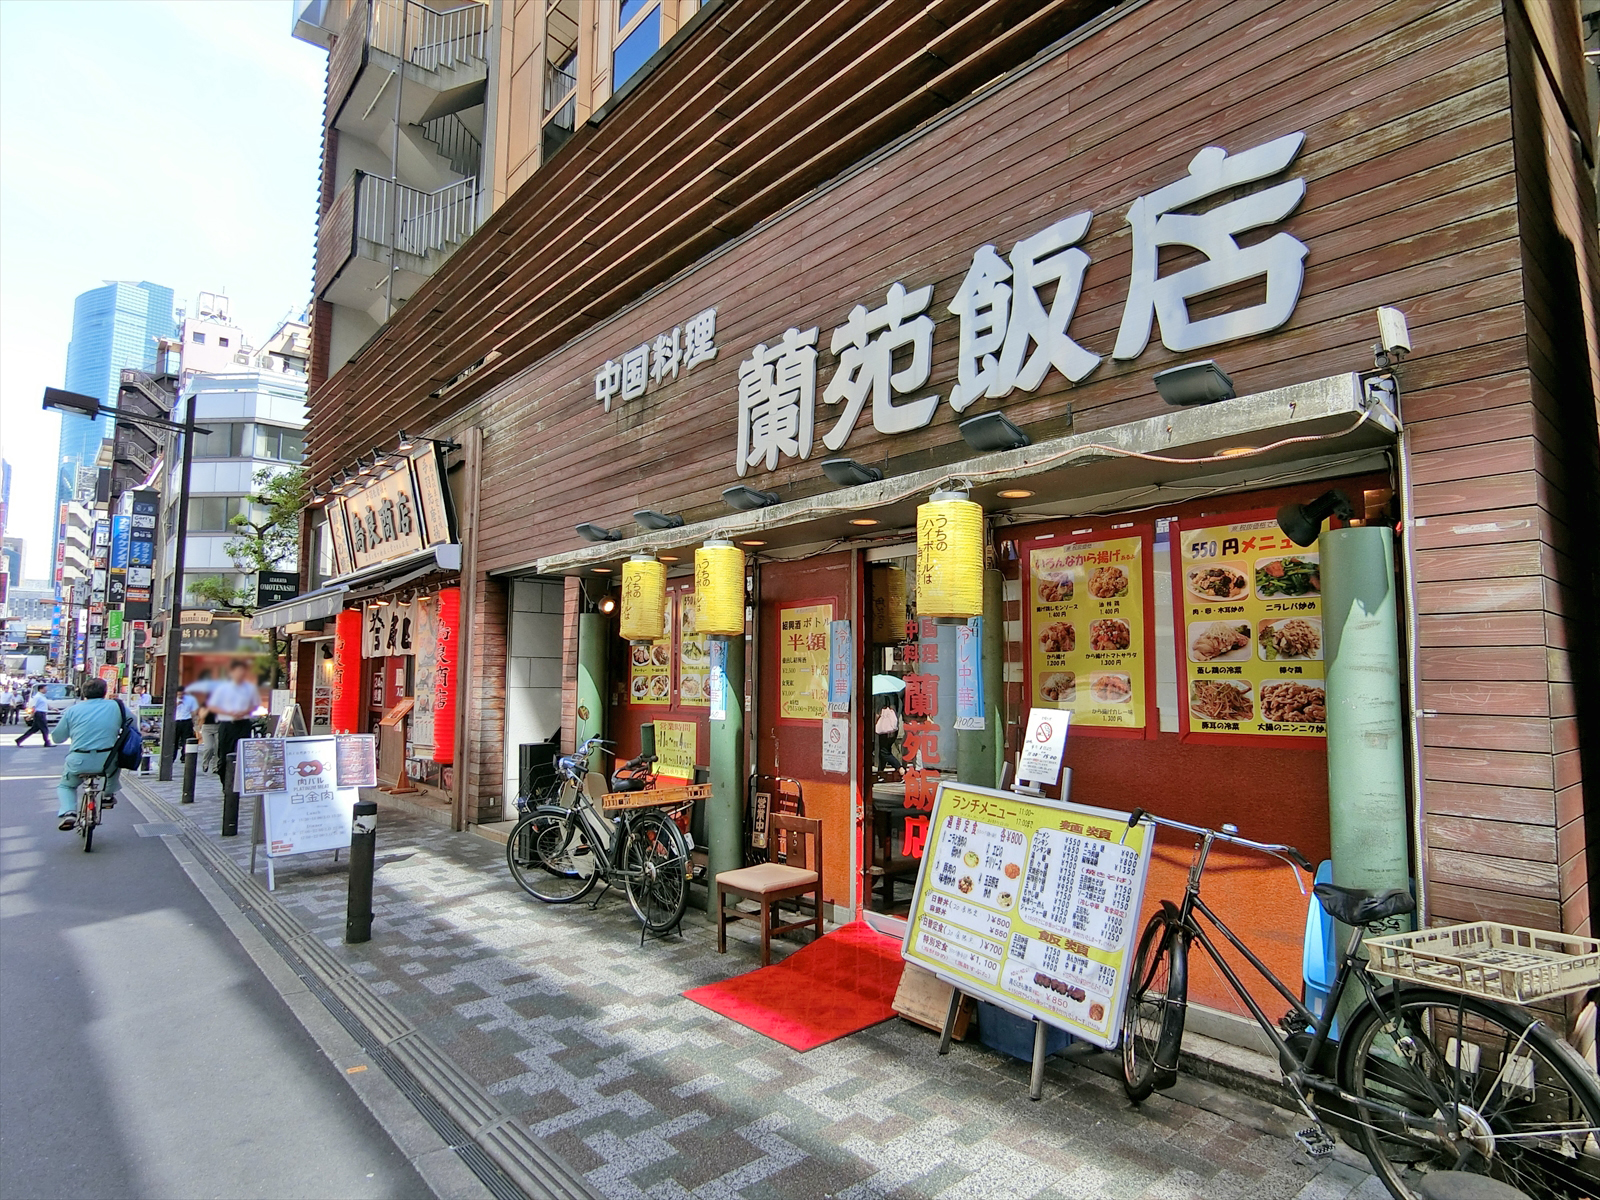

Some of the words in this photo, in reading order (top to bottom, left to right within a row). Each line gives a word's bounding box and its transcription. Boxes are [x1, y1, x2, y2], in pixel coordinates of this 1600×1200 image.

[736, 131, 1309, 477] 蘭苑飯店
[595, 307, 717, 413] 中国料理
[351, 490, 412, 553] 鳥良商店
[935, 514, 948, 552] うちの
[921, 519, 934, 584] ハイボールは
[701, 558, 710, 587] うちの
[260, 583, 295, 591] OMOTENASHI
[633, 572, 641, 598] うちの
[624, 576, 632, 620] ハイボールは
[1266, 602, 1316, 612] ニラレバ炒め
[782, 620, 801, 630] 紹興酒
[803, 617, 831, 628] ボトル
[905, 619, 938, 639] 中国
[787, 633, 827, 651] 半額
[904, 644, 939, 664] 料理
[1085, 652, 1137, 660] から揚げトマトサラダ
[835, 628, 848, 696] 冷し中華
[958, 625, 974, 710] 冷し中華
[660, 722, 690, 732] 営業時間
[1257, 723, 1326, 734] 大腸のニンニク炒
[297, 778, 324, 786] 肉バル
[291, 790, 334, 804] 白金肉
[953, 795, 1017, 819] ランチメニュー
[756, 797, 767, 831] 営業中
[1036, 830, 1050, 839] ラーメン
[1065, 837, 1081, 847] ¥550
[1034, 837, 1049, 846] ワンタン
[1064, 845, 1079, 854] ¥650
[1063, 852, 1078, 862] ¥750
[1121, 850, 1139, 861] ¥900
[1061, 860, 1077, 870] ¥700
[1120, 858, 1137, 868] ¥800
[1060, 868, 1075, 878] ¥750
[1114, 864, 1136, 876] ¥1350
[1059, 875, 1074, 885] ¥950
[1057, 883, 1072, 893] ¥950
[1116, 884, 1132, 895] ¥750
[1056, 890, 1071, 901] ¥750
[1114, 892, 1130, 903] ¥750
[1054, 898, 1069, 908] ¥700
[1113, 900, 1129, 910] ¥750
[1053, 906, 1068, 916] ¥750
[1051, 913, 1066, 924] ¥800
[1108, 916, 1122, 926] ¥900
[990, 927, 1008, 939] ¥550
[1104, 923, 1123, 935] ¥1000
[1101, 930, 1120, 942] ¥1250
[922, 934, 948, 953] 特別定食
[1046, 945, 1060, 956] ¥750
[1044, 953, 1059, 964] ¥900
[1043, 960, 1057, 972] ¥900
[1099, 965, 1115, 977] ¥800
[1098, 974, 1114, 987] ¥750
[1045, 992, 1068, 1009] ¥850
